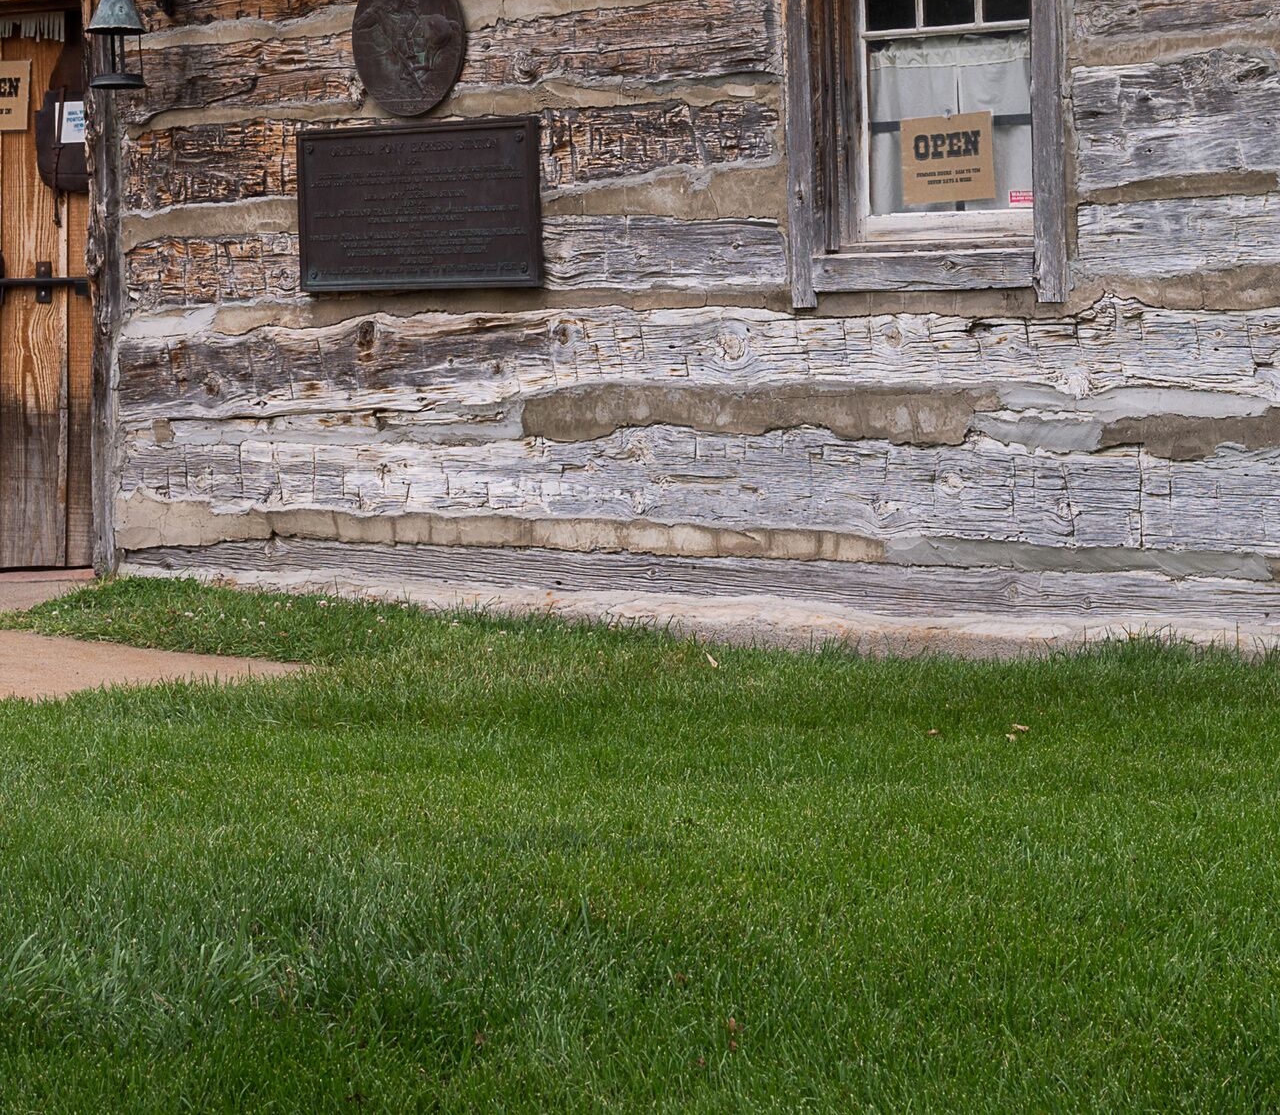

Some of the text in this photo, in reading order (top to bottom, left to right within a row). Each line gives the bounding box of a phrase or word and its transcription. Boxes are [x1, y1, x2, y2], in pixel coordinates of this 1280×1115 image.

[380, 142, 404, 155] PONY
[411, 141, 454, 153] EXPRESS
[459, 138, 498, 151] STATION
[913, 130, 981, 161] OPEN
